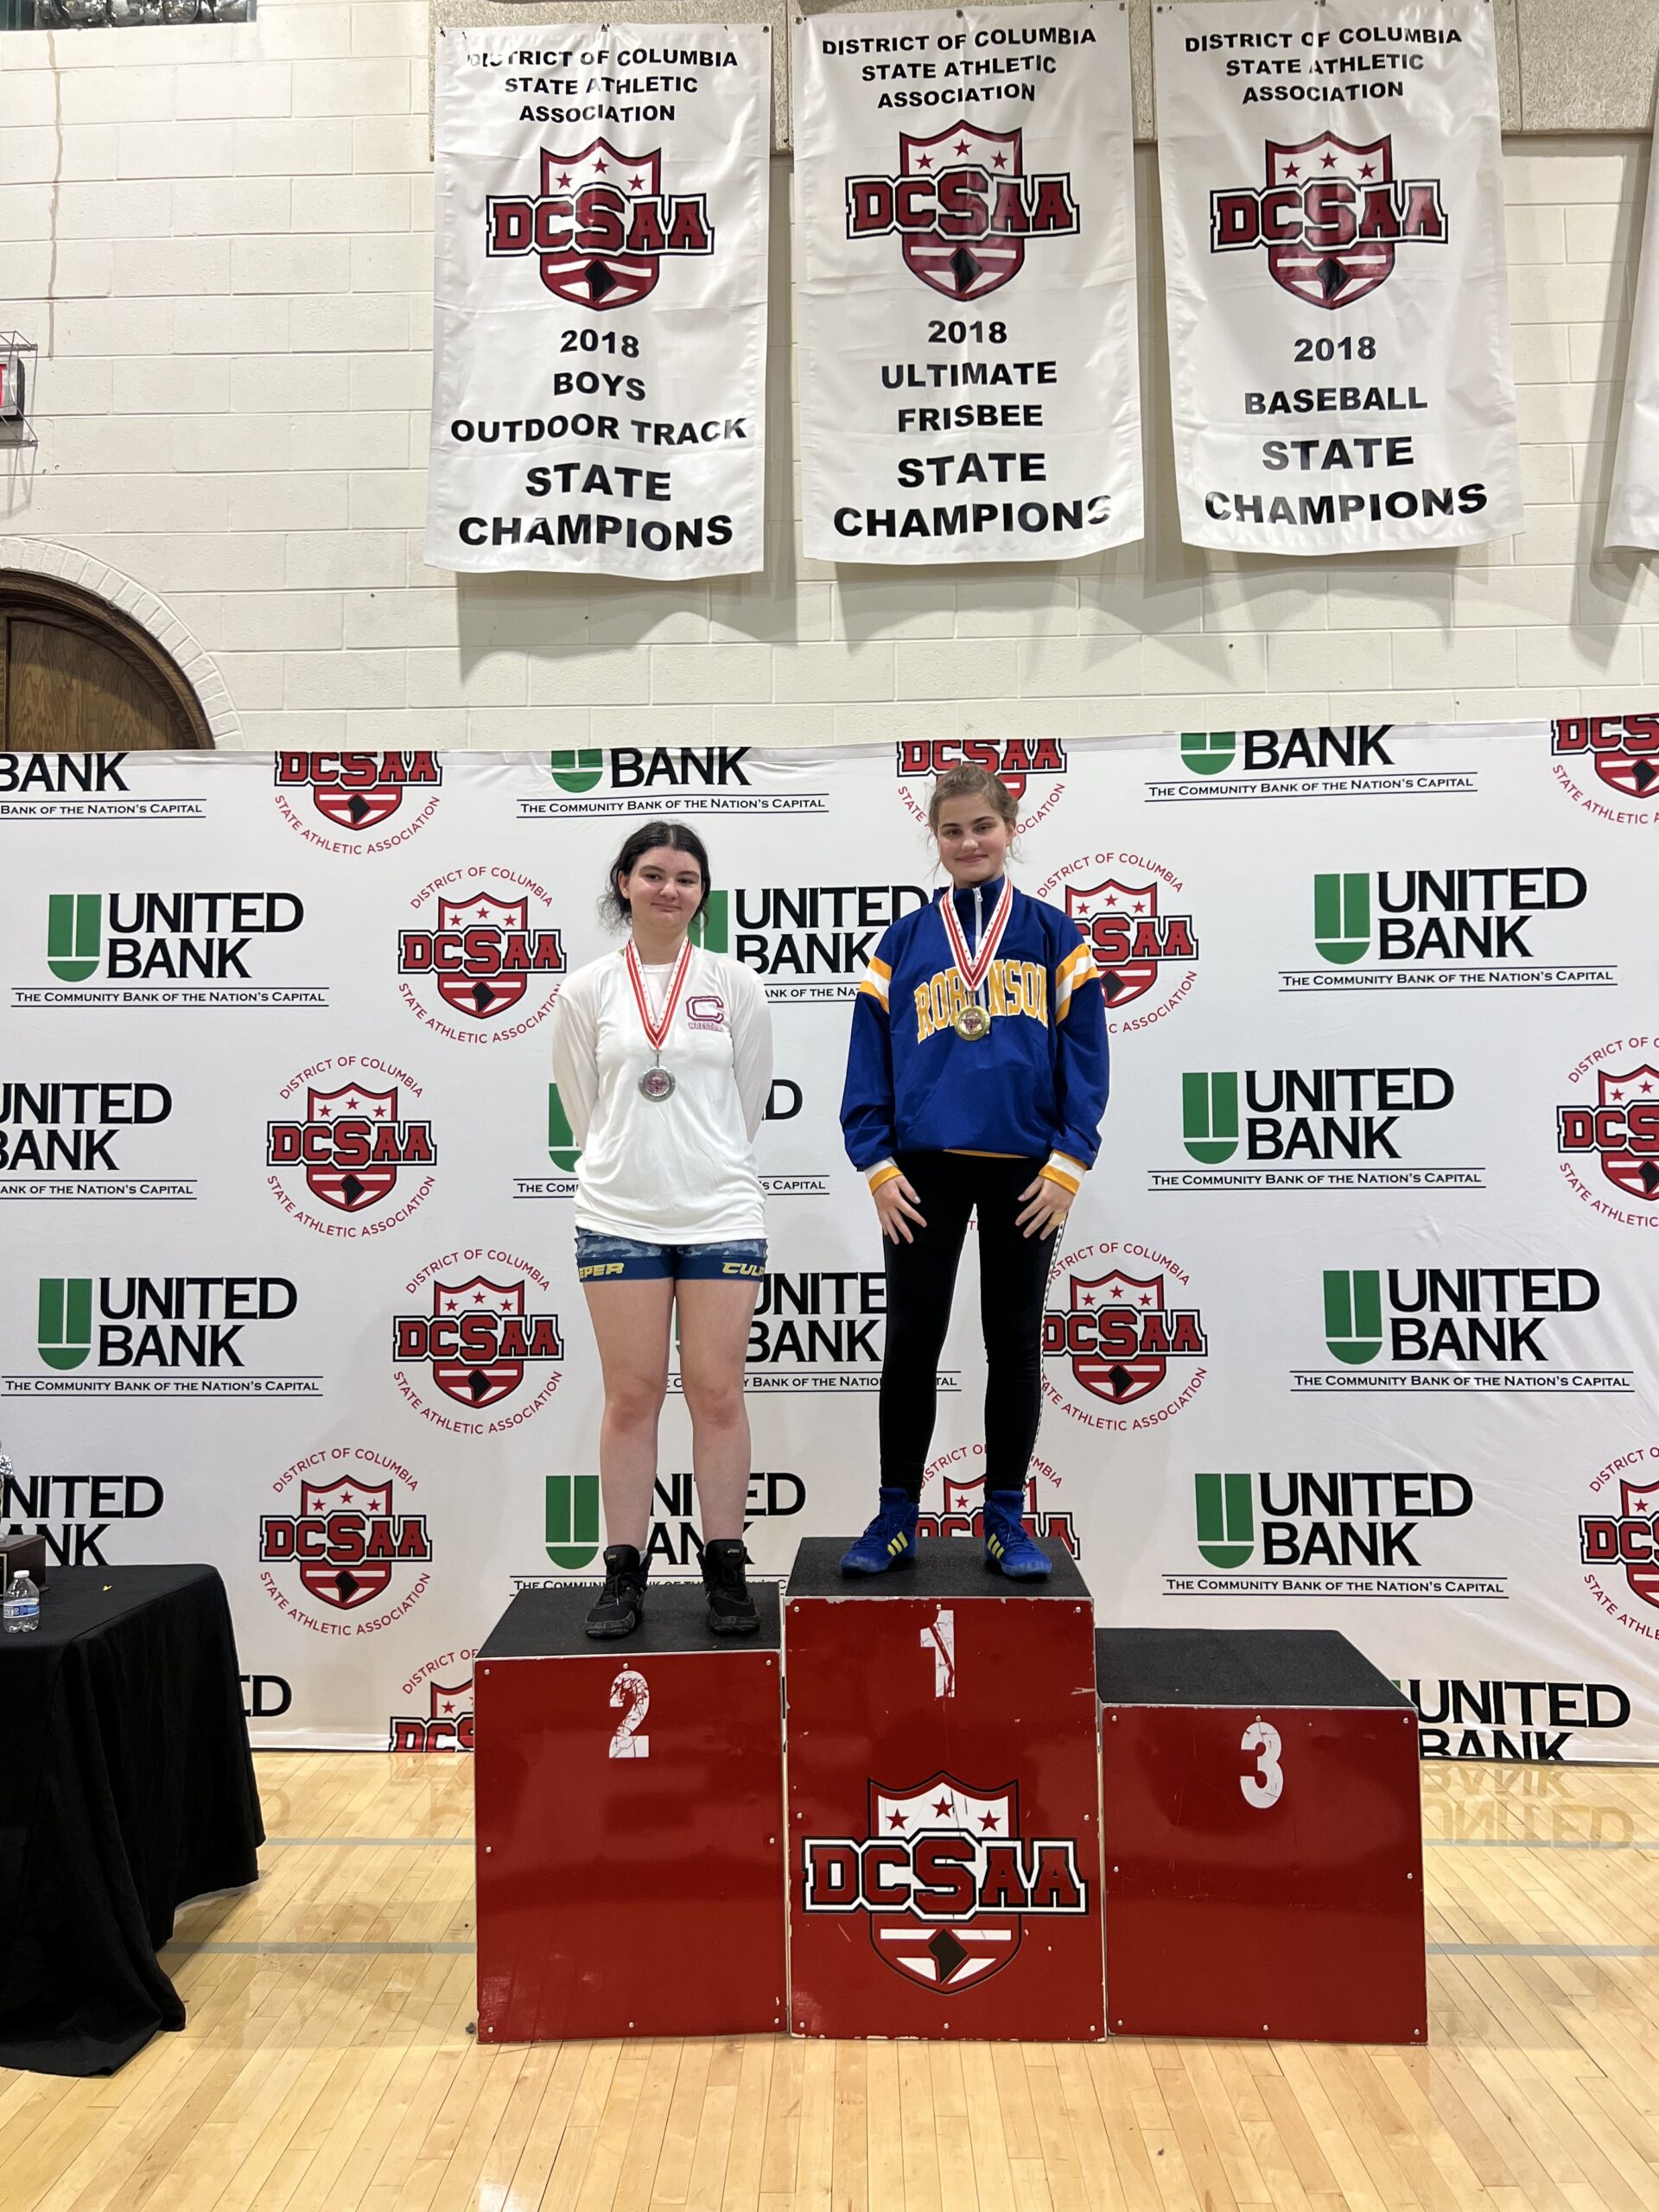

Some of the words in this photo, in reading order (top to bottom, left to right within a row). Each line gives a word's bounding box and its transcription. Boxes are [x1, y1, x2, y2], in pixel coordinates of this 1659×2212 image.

[581, 50, 609, 66] OF
[617, 49, 738, 67] COLUMBIA
[822, 35, 929, 55] DISTRICT
[937, 35, 966, 50] OF
[974, 28, 1096, 48] COLUMBIA
[1185, 33, 1293, 53] DISTRICT
[1300, 31, 1331, 48] OF
[1338, 27, 1462, 45] COLUMBIA
[505, 78, 578, 95] STATE
[586, 76, 698, 95] ATHLETIC
[861, 63, 936, 81] STATE
[944, 54, 1056, 77] ATHLETIC
[1226, 59, 1301, 76] STATE
[1309, 53, 1424, 74] ATHLETIC
[519, 104, 674, 123] ASSOCIATION
[878, 83, 1034, 109] ASSOCIATION
[1243, 81, 1403, 104] ASSOCIATION
[486, 181, 715, 257] DCSAA
[846, 164, 1079, 240] DCSAA
[1211, 177, 1448, 252] DCSAA
[560, 328, 639, 359] 2018
[928, 320, 1007, 344] 2018
[1294, 336, 1376, 363] 2018
[554, 372, 645, 401] BOYS
[881, 360, 1057, 389] ULTIMATE
[898, 404, 1043, 432] FRISBEE
[1244, 386, 1427, 415] BASEBALL
[451, 414, 620, 443] OUTDOOR
[631, 417, 747, 446] TRACK
[897, 452, 1046, 488] STATE
[1262, 436, 1414, 471] STATE
[525, 462, 671, 501] STATE
[834, 495, 1111, 537] CHAMPIONS
[1205, 484, 1487, 525] CHAMPIONS
[459, 514, 733, 551] CHAMPIONS
[610, 747, 753, 789] BANK
[1243, 724, 1395, 771] BANK
[276, 751, 442, 790] DCSAA
[1148, 786, 1176, 797] THE
[1178, 785, 1258, 796] COMMUNITY
[1260, 783, 1299, 793] BANK
[1301, 782, 1319, 791] OF
[1321, 781, 1348, 791] THE
[1351, 778, 1414, 790] NATION'S
[1416, 777, 1474, 788] CAPITAL
[274, 795, 303, 830] STATE
[300, 829, 362, 855] ATHLETIC
[366, 796, 441, 855] ASSOCIATION
[519, 803, 547, 813] THE
[549, 802, 625, 813] COMMUNITY
[626, 800, 663, 810] BANK
[664, 799, 682, 809] OF
[683, 799, 709, 809] THE
[710, 798, 770, 809] NATION'S
[772, 798, 826, 809] CAPITAL
[410, 869, 463, 908] DISTRICT
[467, 867, 486, 877] OF
[491, 867, 553, 907] COLUMBIA
[1377, 866, 1587, 912] UNITED
[109, 892, 304, 933] UNITED
[107, 938, 252, 979] BANK
[399, 925, 566, 977] DCSAA
[734, 932, 877, 976] BANK
[1378, 914, 1535, 961] BANK
[15, 992, 41, 1002] THE
[43, 992, 120, 1002] COMMUNITY
[123, 991, 160, 1002] BANK
[162, 993, 180, 1002] OF
[181, 993, 207, 1002] THE
[209, 991, 270, 1002] NATION'S
[271, 991, 326, 1002] CAPITAL
[398, 982, 428, 1020] STATE
[425, 1018, 487, 1044] ATHLETIC
[686, 995, 724, 1024] C
[279, 1059, 333, 1099] DISTRICT
[337, 1056, 356, 1066] OF
[360, 1057, 423, 1098] COLUMBIA
[1245, 1067, 1454, 1112] UNITED
[0, 1082, 172, 1125] NITED
[268, 1116, 436, 1170] DCSAA
[1246, 1116, 1402, 1160] BANK
[1151, 1174, 1179, 1185] THE
[1181, 1174, 1262, 1185] COMMUNITY
[1265, 1173, 1305, 1185] BANK
[1306, 1174, 1325, 1185] OF
[1326, 1174, 1355, 1184] THE
[1357, 1173, 1421, 1184] NATION'S
[1424, 1172, 1482, 1183] CAPITAL
[267, 1175, 296, 1212] STATE
[294, 1211, 356, 1237] ATHLETIC
[361, 1176, 435, 1236] ASSOCIATION
[406, 1252, 459, 1294] DISTRICT
[464, 1249, 483, 1260] OF
[487, 1249, 550, 1291] COLUMBIA
[1123, 1243, 1190, 1286] COLUMBIA
[99, 1276, 298, 1320] UNITED
[1387, 1267, 1600, 1313] UNITED
[98, 1324, 245, 1367] BANK
[394, 1311, 563, 1366] DCSAA
[1043, 1306, 1208, 1360] DCSAA
[1389, 1317, 1549, 1362] BANK
[4, 1380, 32, 1391] THE
[34, 1380, 111, 1391] COMMUNITY
[114, 1380, 151, 1391] BANK
[153, 1382, 171, 1391] OF
[173, 1382, 199, 1391] THE
[201, 1380, 263, 1391] NATION'S
[264, 1380, 320, 1391] CAPITAL
[1060, 1403, 1128, 1431] ATHLETIC
[1133, 1367, 1207, 1430] ASSOCIATION
[1294, 1375, 1323, 1386] THE
[1325, 1375, 1408, 1386] COMMUNITY
[1410, 1375, 1451, 1386] BANK
[1452, 1376, 1471, 1387] OF
[1473, 1376, 1501, 1387] THE
[1503, 1375, 1569, 1387] NATION'S
[1572, 1376, 1630, 1387] CAPITAL
[394, 1371, 423, 1409] STATE
[420, 1408, 484, 1434] ATHLETIC
[488, 1371, 563, 1433] ASSOCIATION
[272, 1451, 327, 1493] DISTRICT
[331, 1448, 350, 1459] OF
[355, 1448, 418, 1491] COLUMBIA
[2, 1474, 164, 1519] NITED
[1259, 1471, 1473, 1518] UNITED
[260, 1511, 432, 1567] DCSAA
[1262, 1521, 1422, 1567] BANK
[260, 1572, 289, 1610] STATE
[287, 1608, 351, 1636] ATHLETIC
[356, 1573, 430, 1635] ASSOCIATION
[1166, 1579, 1195, 1590] THE
[1197, 1579, 1280, 1591] COMMUNITY
[1282, 1580, 1322, 1591] BANK
[1325, 1581, 1344, 1591] OF
[1345, 1581, 1374, 1592] THE
[1376, 1580, 1442, 1592] NATION'S
[1445, 1580, 1504, 1593] CAPITAL
[919, 1609, 955, 1698] 1
[608, 1669, 650, 1758] 2
[1409, 1679, 1631, 1729] UNITED
[1239, 1721, 1285, 1808] 3
[1421, 1729, 1574, 1760] BANK
[803, 1828, 1089, 1922] DCSAA
